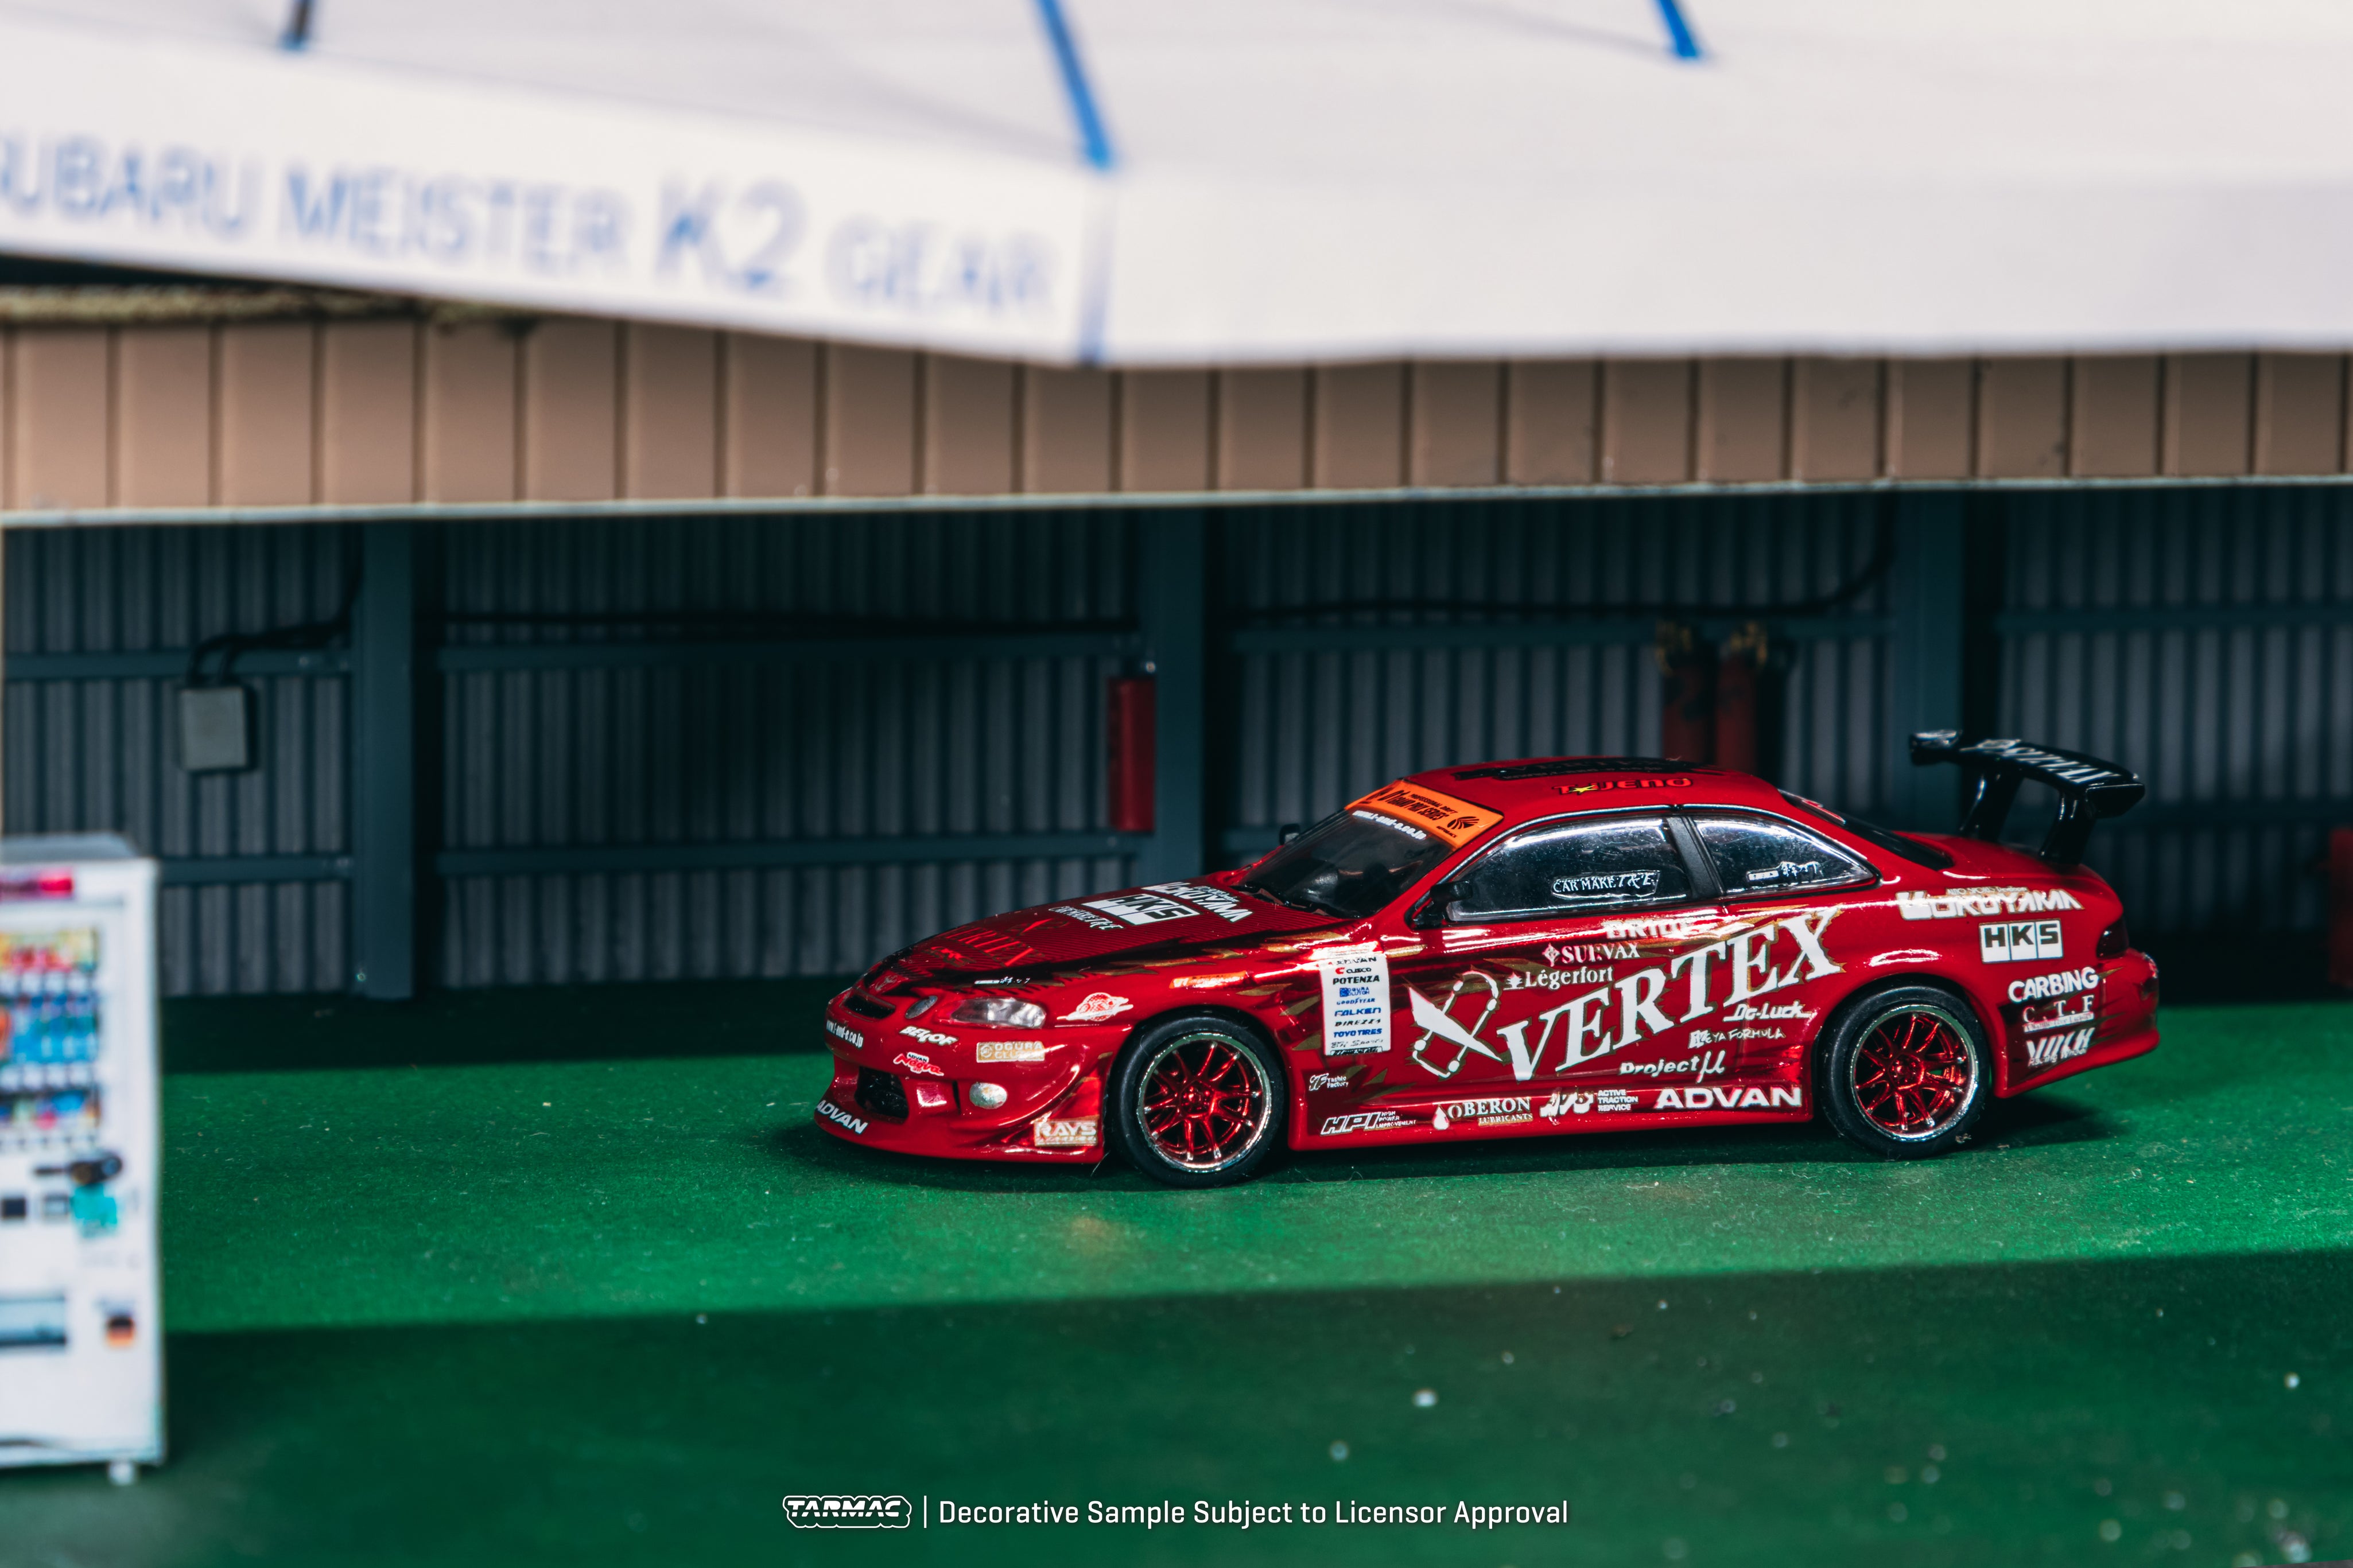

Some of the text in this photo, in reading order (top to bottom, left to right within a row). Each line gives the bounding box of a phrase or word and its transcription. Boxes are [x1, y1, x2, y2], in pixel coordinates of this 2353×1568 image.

[281, 161, 632, 278] MEISTER
[657, 172, 805, 295] K2
[1106, 894, 1194, 920] HKS
[1982, 922, 2061, 950] HKS
[1333, 975, 1380, 985] POTENZA
[2008, 966, 2100, 1003] CARBING
[1496, 909, 1841, 1081] VERTEX
[1358, 1028, 1383, 1036] TIRES
[1447, 1096, 1532, 1119] OBERON
[1598, 1096, 1638, 1104] TRACTION
[1598, 1104, 1632, 1112] SERVICE
[1653, 1087, 1803, 1110] ADVAN
[816, 1100, 868, 1134] ADVAN
[1478, 1113, 1533, 1125] LUBRICANTS
[1036, 1122, 1097, 1137] RAYS
